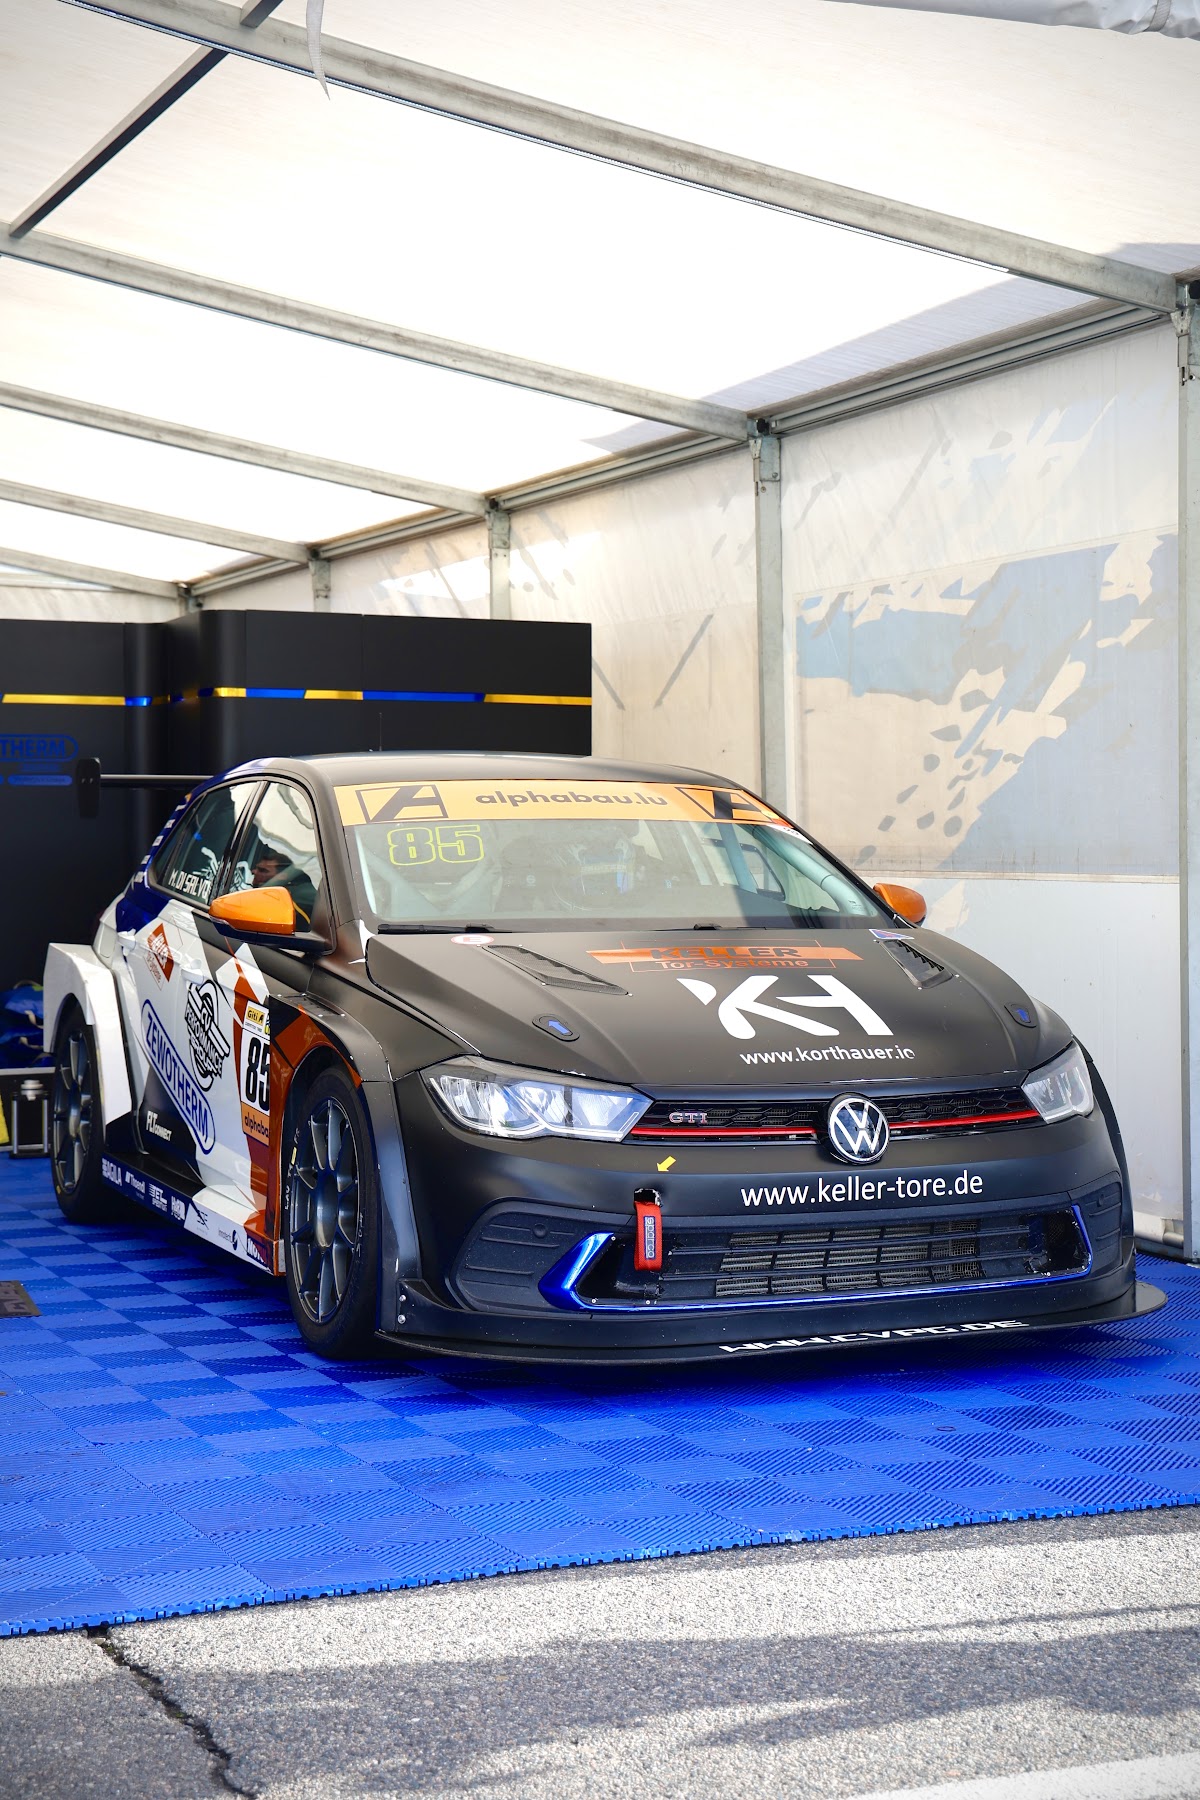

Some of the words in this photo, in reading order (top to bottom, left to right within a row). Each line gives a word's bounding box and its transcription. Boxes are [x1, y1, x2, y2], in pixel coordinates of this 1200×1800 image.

[475, 790, 668, 806] alphabau.lu
[387, 824, 485, 866] 85
[651, 947, 803, 960] KELLER
[655, 957, 809, 969] Tor-Systeme
[247, 1010, 258, 1021] Giti
[185, 1002, 223, 1073] PERFORMANCE
[740, 1045, 915, 1065] www.korthauer.io
[145, 1011, 208, 1143] ZEWOTHERM
[245, 1036, 270, 1112] 85
[668, 1112, 708, 1124] GTI
[741, 1170, 983, 1206] www.keller-tore.de
[645, 1216, 655, 1258] sparco
[719, 1320, 1029, 1353] WWW.CVPG.DE
